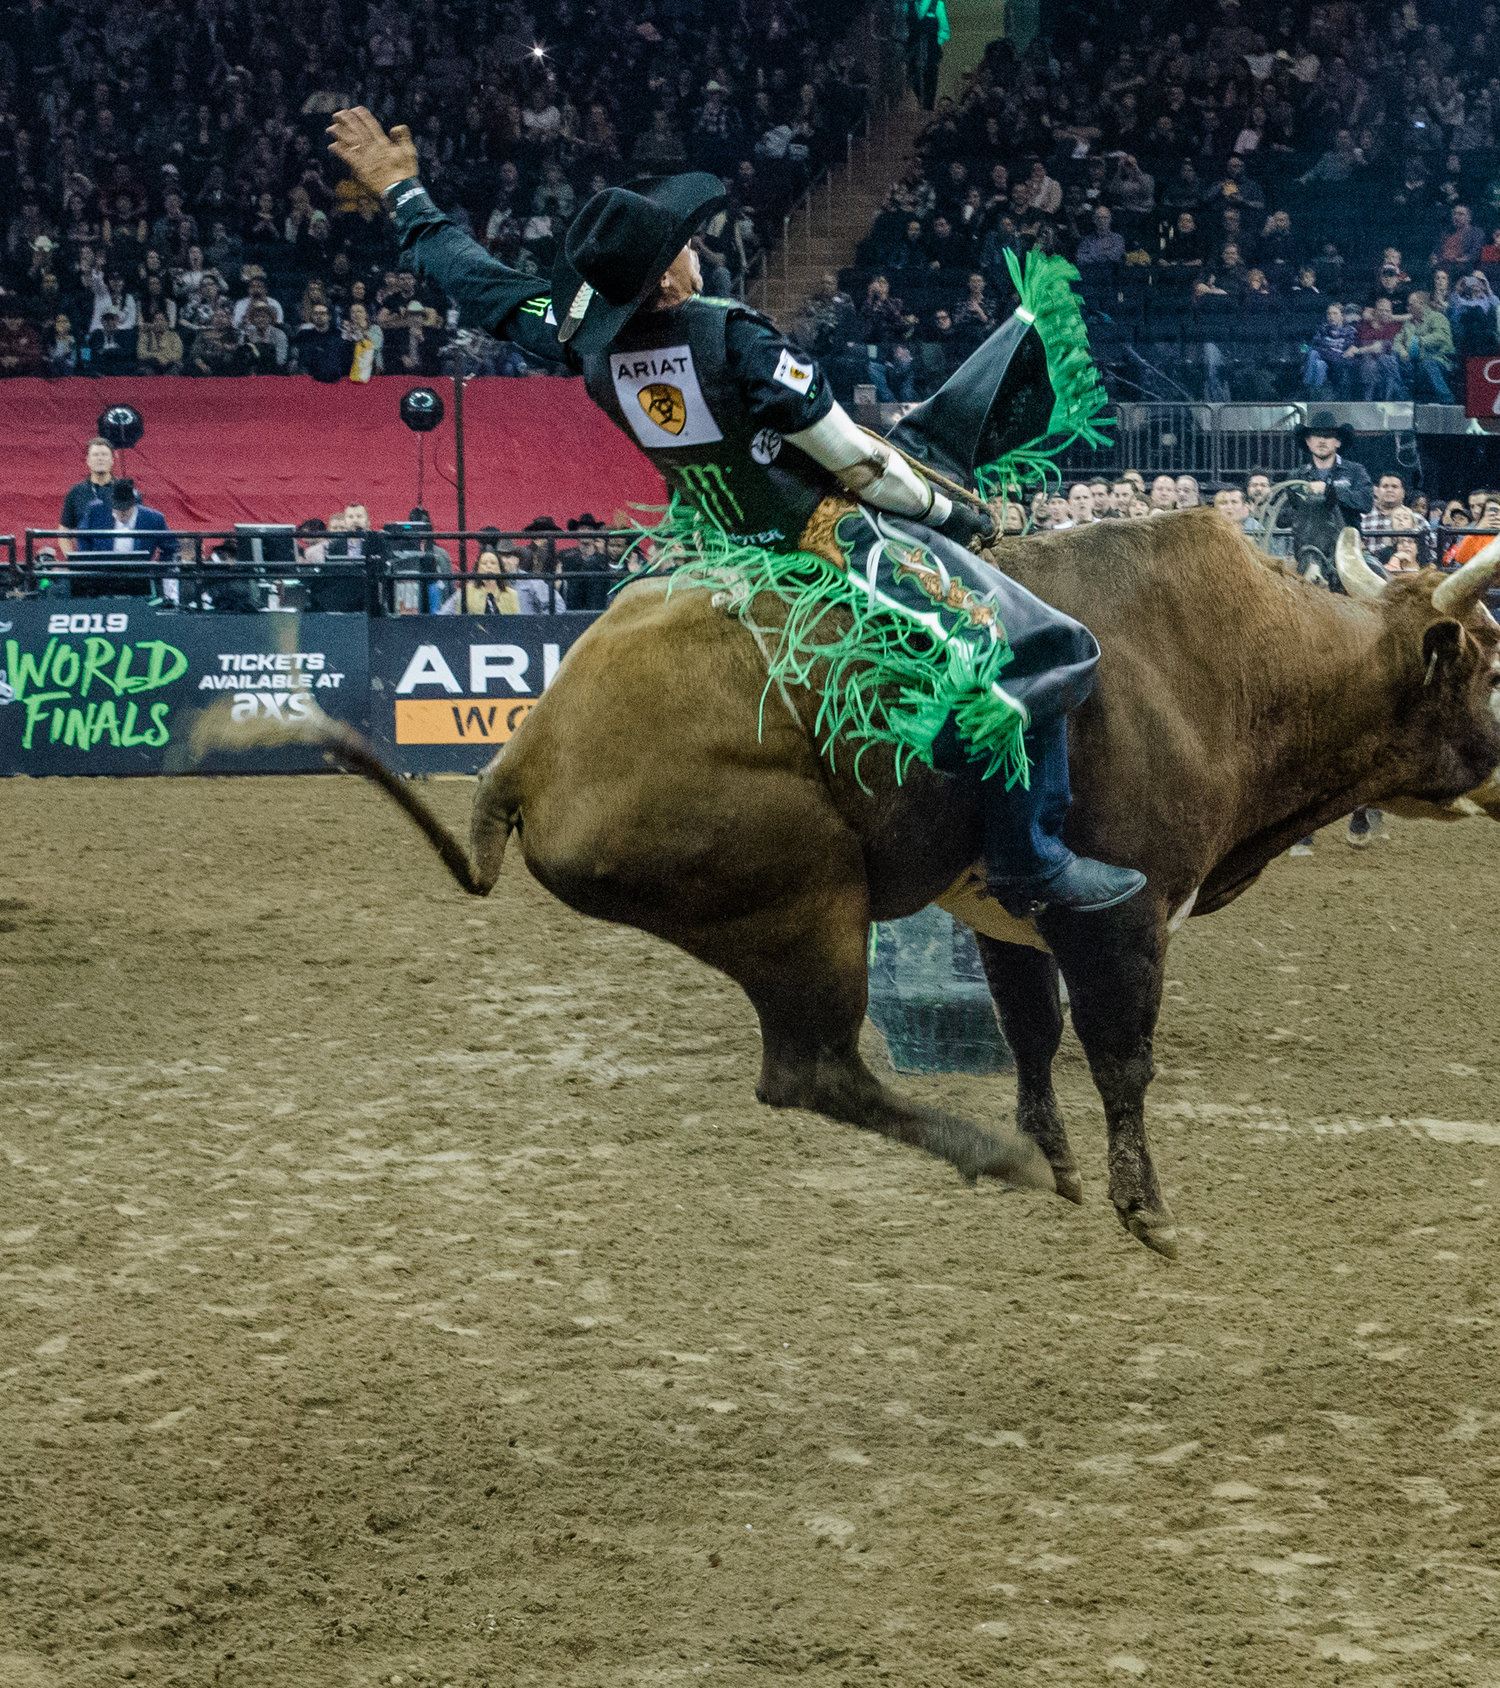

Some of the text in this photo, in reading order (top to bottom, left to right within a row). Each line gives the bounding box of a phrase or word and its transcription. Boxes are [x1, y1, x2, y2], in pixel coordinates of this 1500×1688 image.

[616, 357, 688, 380] ARIAT
[49, 613, 128, 634] 2019
[6, 636, 189, 701] WORLD
[217, 653, 325, 671] TICKETS
[198, 673, 345, 690] AVAILABLE AT
[22, 691, 170, 750] FINALS
